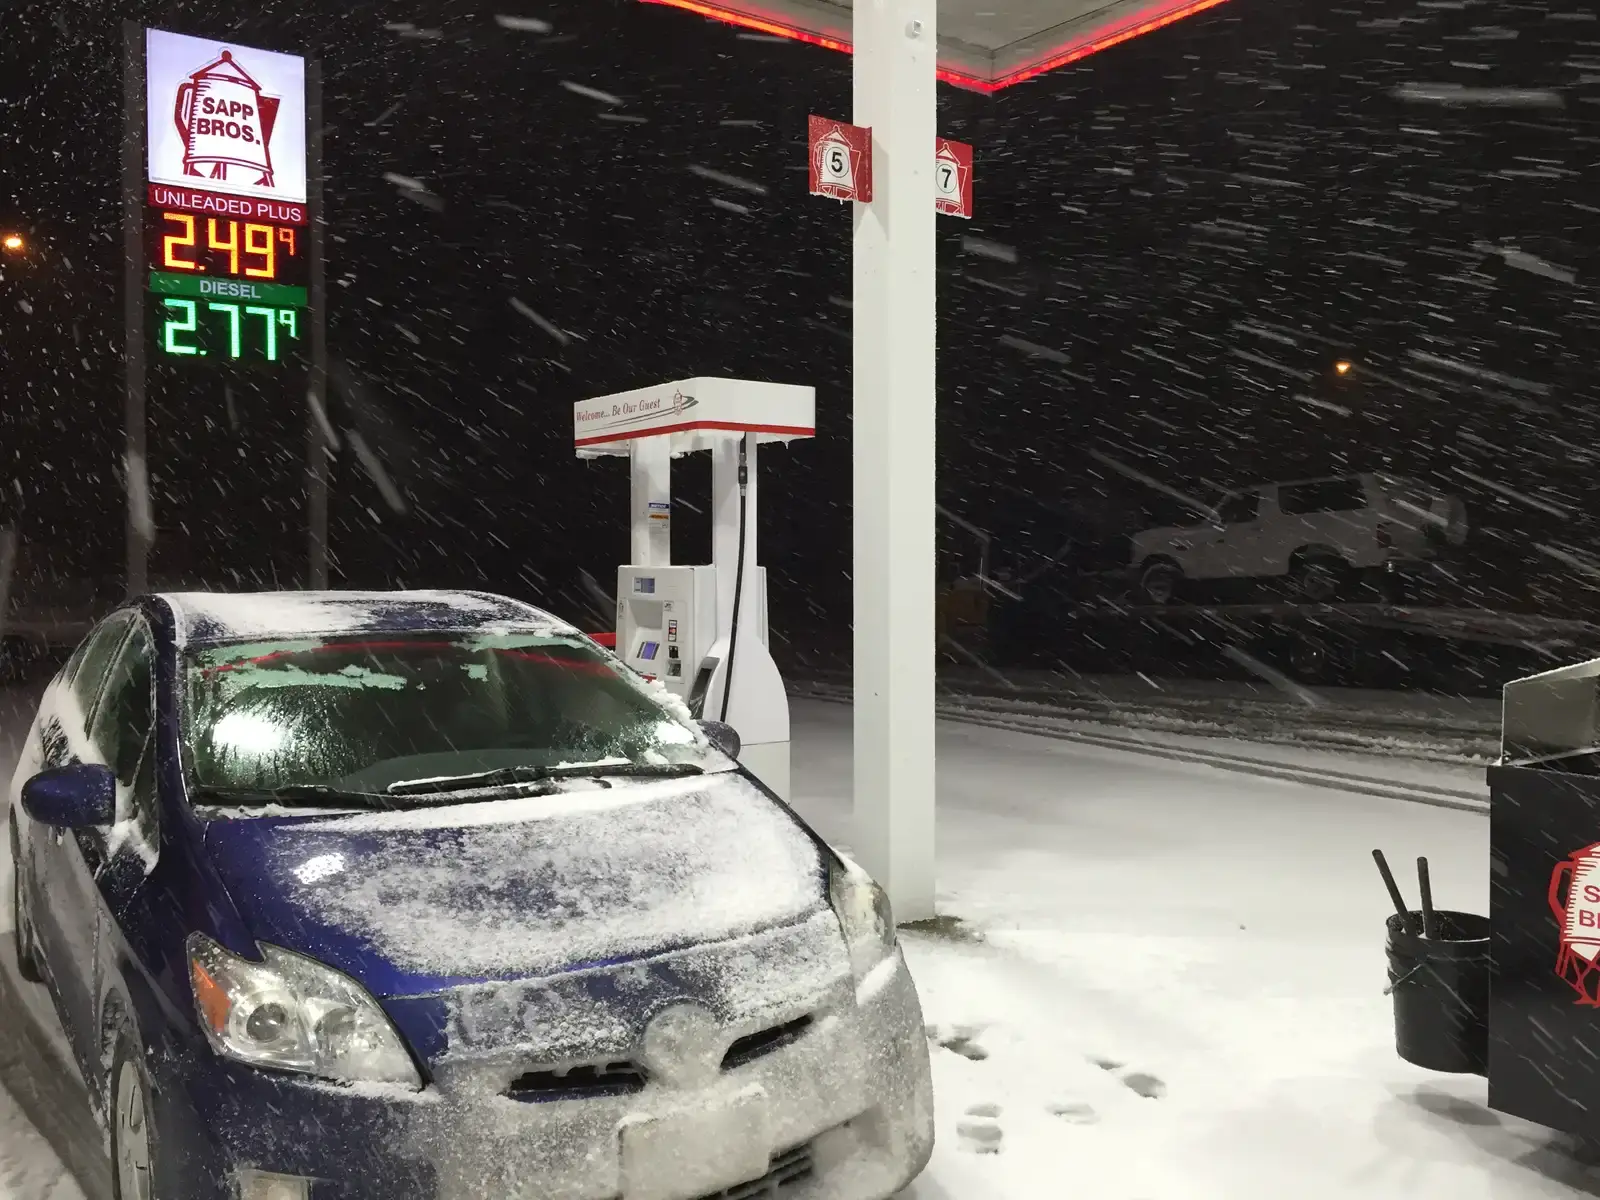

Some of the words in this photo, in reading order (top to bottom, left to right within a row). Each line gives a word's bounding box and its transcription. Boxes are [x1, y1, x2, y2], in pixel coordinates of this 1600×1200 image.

[202, 97, 254, 120] SAPP
[197, 118, 261, 145] BROS.
[831, 151, 843, 173] 5
[941, 168, 952, 189] 7
[154, 189, 252, 215] UNLEADED
[257, 203, 301, 221] PLUS
[200, 279, 261, 299] DIESEL
[612, 404, 621, 417] Be
[623, 402, 637, 414] Our
[639, 398, 661, 411] Guest
